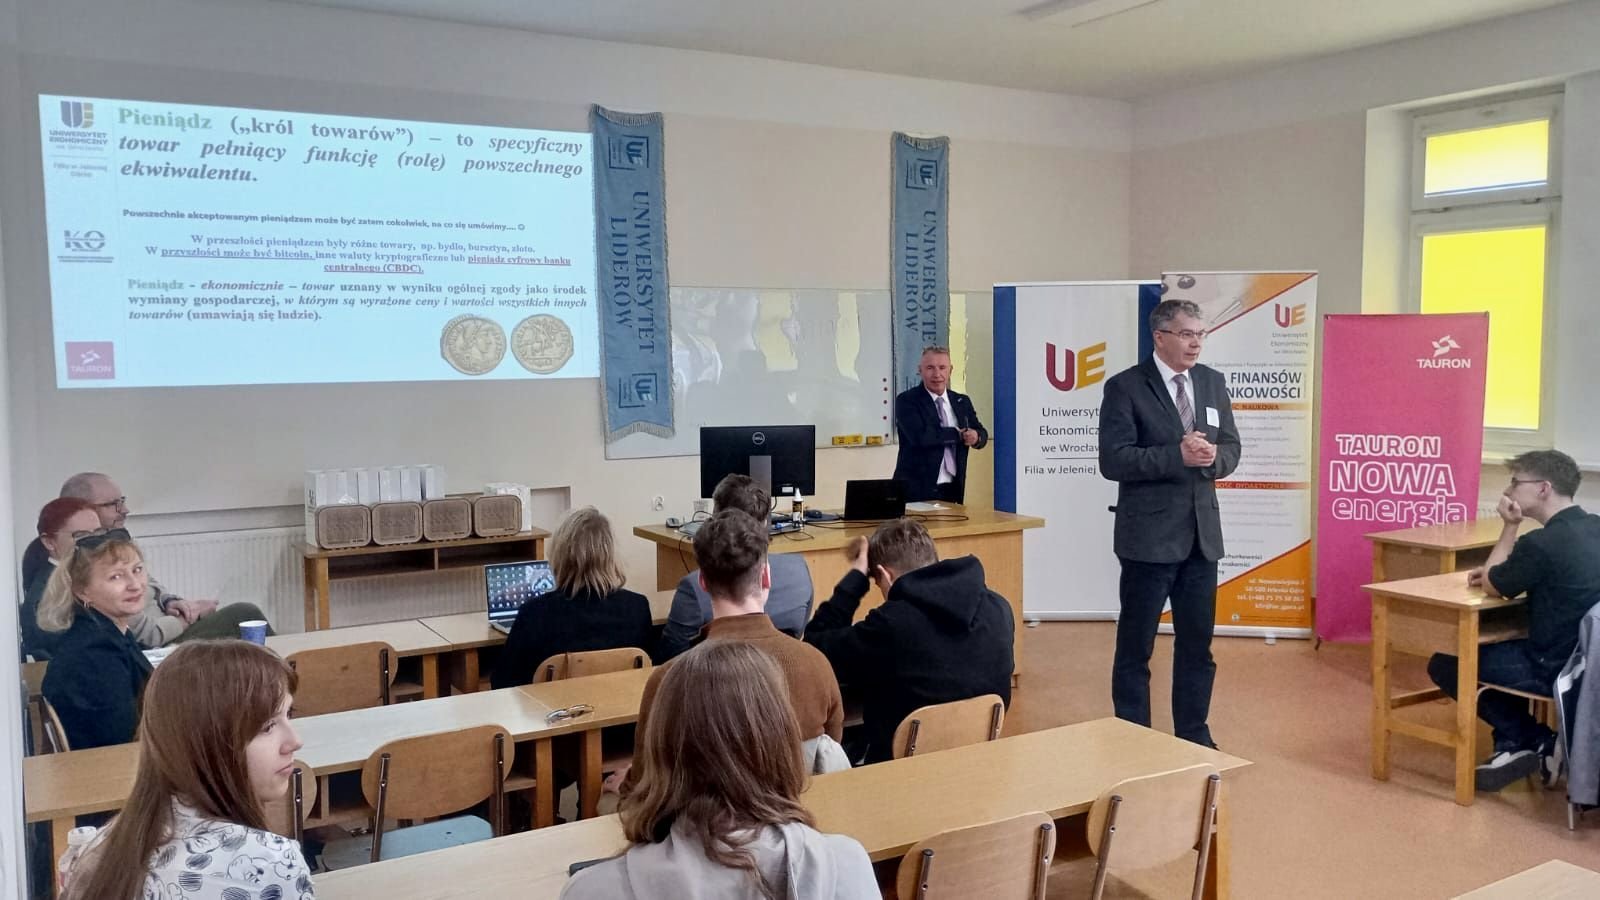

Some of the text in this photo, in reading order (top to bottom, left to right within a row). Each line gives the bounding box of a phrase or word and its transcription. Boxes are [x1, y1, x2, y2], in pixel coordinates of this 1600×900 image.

[49, 130, 108, 138] UNIWERSYTET
[118, 108, 212, 132] Pieniądz
[230, 116, 294, 136] („król
[311, 122, 414, 146] towarów”)
[456, 134, 474, 147] to
[488, 137, 582, 157] specyficzny
[118, 136, 583, 178] towar pełniący funkcję (rolę) powszechnego
[120, 160, 258, 182] ekwiwalentu.
[122, 209, 186, 219] Powszechnie
[188, 211, 258, 223] akceptowanym
[260, 214, 313, 225] pieniądzem
[315, 216, 338, 225] może
[340, 216, 357, 227] być
[358, 218, 384, 226] zatem
[386, 218, 430, 228] cokolwiek,
[455, 221, 465, 230] się
[190, 235, 536, 253] W przeszłości pieniądzem były różne towary, np. bydło, bursztyn, złoto.
[144, 246, 571, 266] W przyszłości może być bitcoin, inne waluty kryptograficzne lub pieniądz cyfrowy banku
[324, 264, 424, 274] centralnego (CBDC).
[610, 216, 633, 328] LIDERÓW
[632, 191, 655, 354] UNIWERSYTET
[922, 210, 937, 346] UNIWERSYTE
[127, 279, 184, 292] Pieniądz
[201, 280, 284, 291] ekonomicznie
[302, 281, 335, 291] towar
[340, 284, 382, 294] uznany
[402, 283, 443, 294] wyniku
[447, 284, 486, 294] ogólnej
[490, 285, 522, 295] zgody
[525, 285, 549, 295] jako
[553, 284, 587, 295] środek
[905, 232, 922, 332] LIDERÓW
[128, 295, 188, 307] wymiany
[193, 295, 280, 307] gospodarczej,
[298, 295, 338, 307] którym
[342, 297, 355, 307] są
[360, 295, 412, 307] wyrażone
[415, 298, 440, 308] ceny
[443, 297, 448, 305] i
[452, 297, 494, 307] wartości
[498, 298, 550, 308] wszystkich
[554, 298, 587, 308] innych
[129, 309, 322, 322] towarów (umawiają się ludzie).
[1275, 303, 1306, 328] UE
[1046, 342, 1106, 392] UE
[1416, 358, 1471, 369] TAURON
[1230, 369, 1302, 384] FINANSÓW
[1226, 384, 1301, 399] NKOWOŚCI
[1042, 408, 1100, 419] Uniwersyt
[1039, 426, 1100, 436] Ekonomicz
[1060, 444, 1099, 452] Wrocła
[1336, 434, 1441, 458] TAURON
[1024, 465, 1045, 475] Filia
[1059, 465, 1097, 478] Jeleniej
[1329, 460, 1456, 497] NOWA
[1332, 495, 1467, 528] energia
